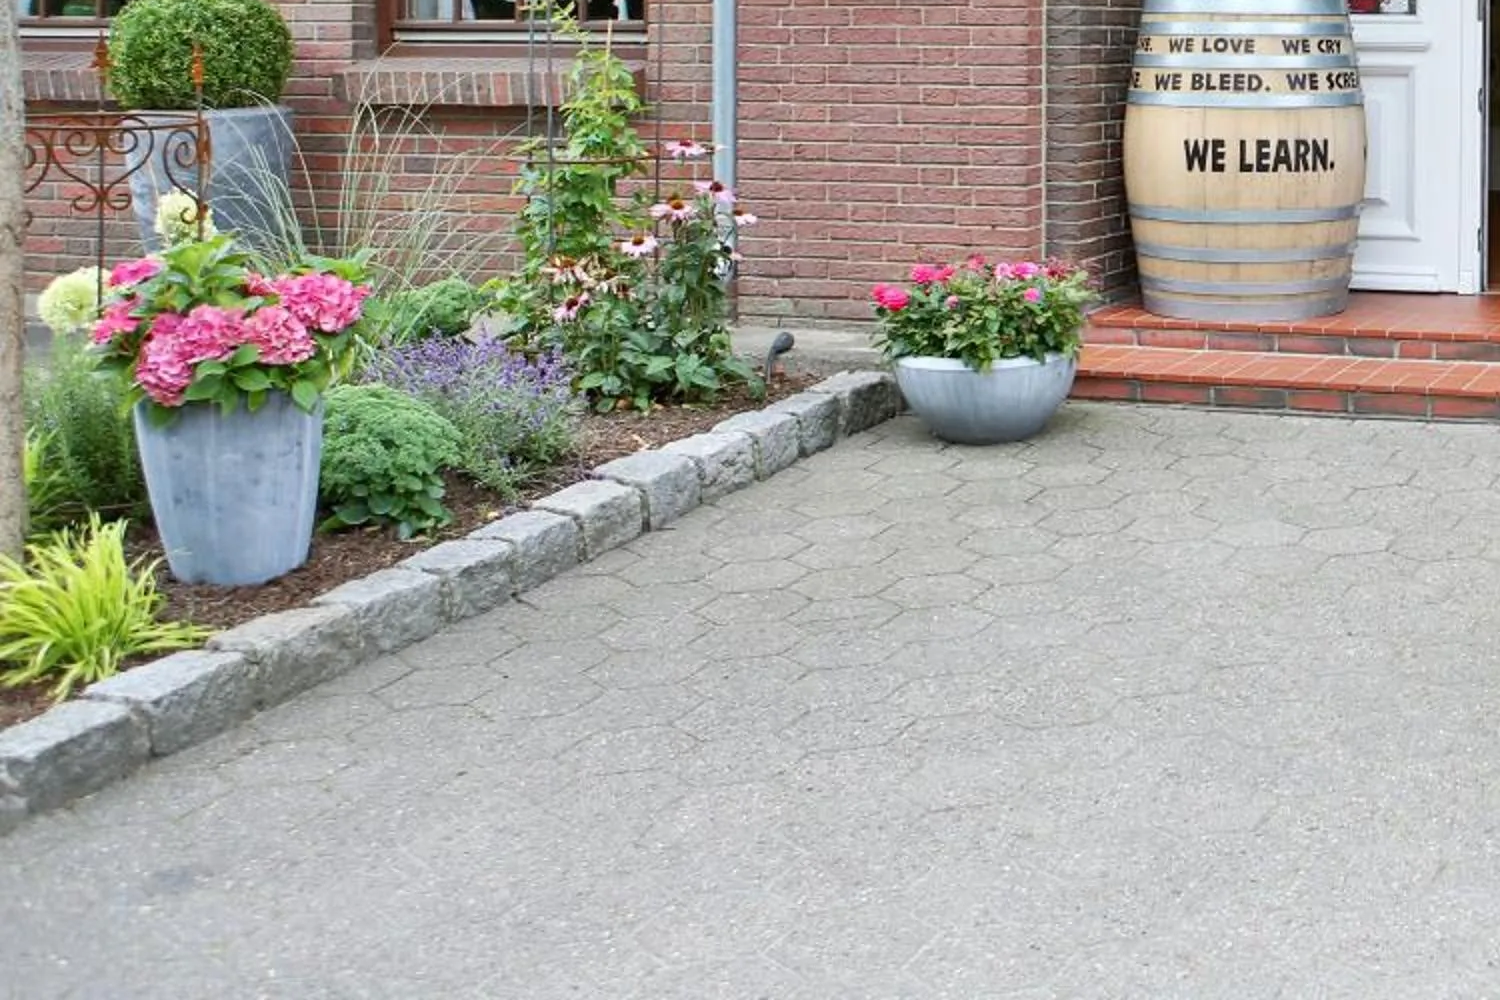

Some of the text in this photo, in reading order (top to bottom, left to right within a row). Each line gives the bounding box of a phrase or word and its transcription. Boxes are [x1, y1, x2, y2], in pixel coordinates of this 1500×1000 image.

[1168, 37, 1195, 53] WE
[1202, 37, 1255, 54] LOVE
[1281, 38, 1311, 55] WE
[1317, 39, 1341, 55] CRY
[1155, 72, 1182, 91] WE
[1191, 72, 1271, 92] BLEED.
[1286, 72, 1319, 91] WE
[1183, 138, 1335, 173] WE LEARN.
